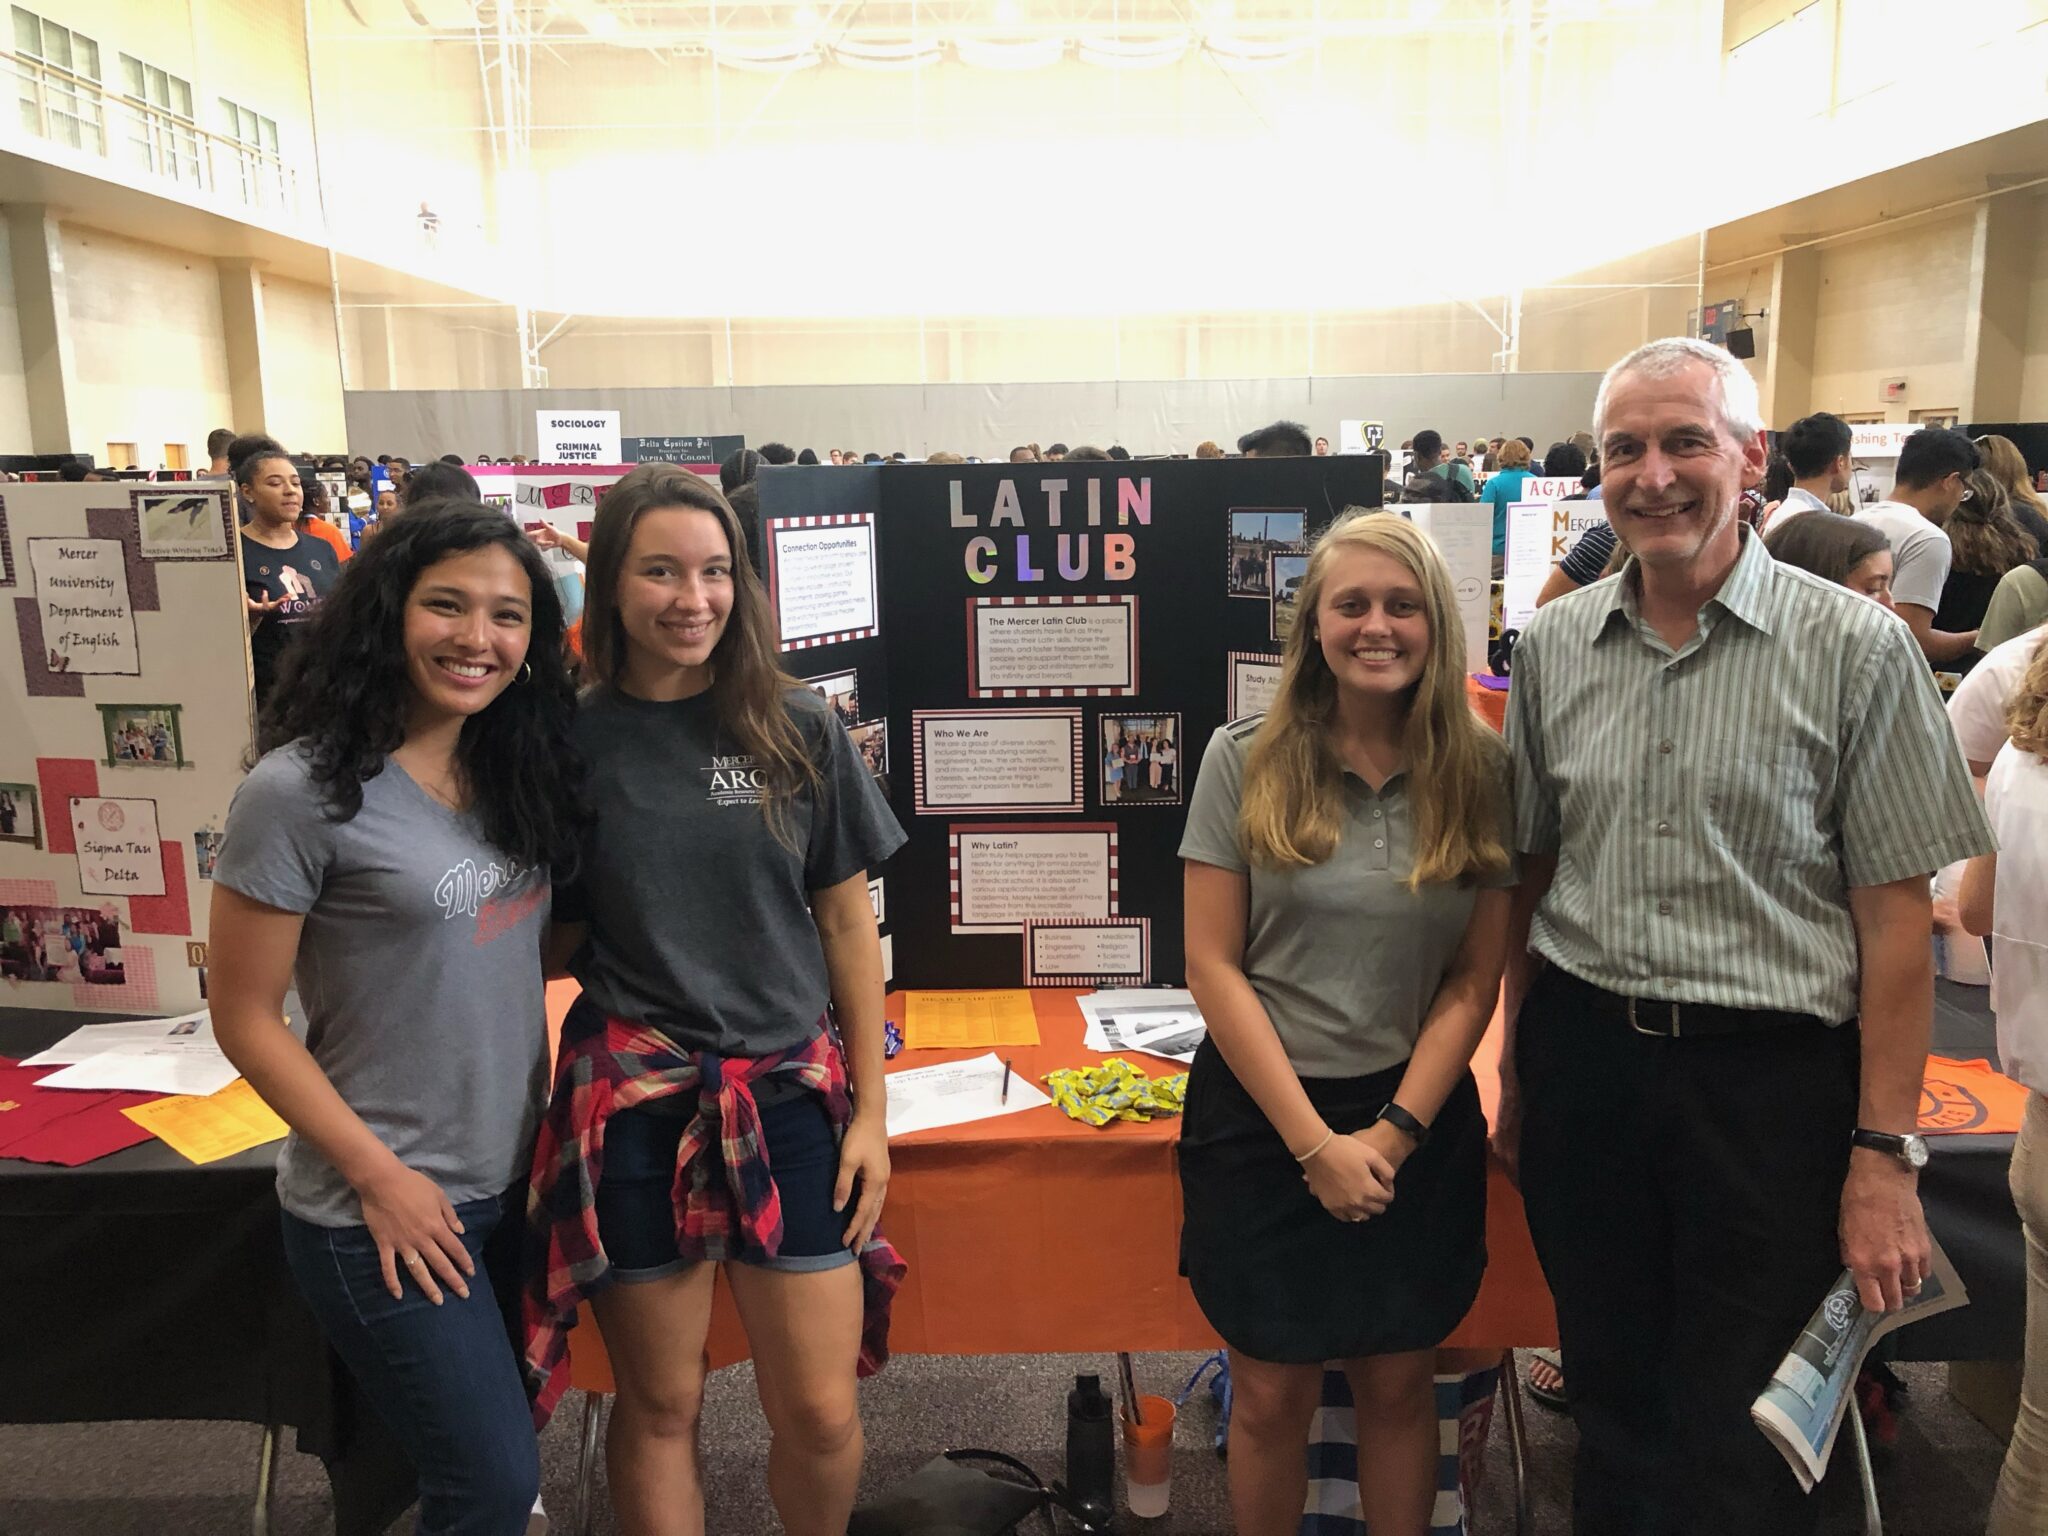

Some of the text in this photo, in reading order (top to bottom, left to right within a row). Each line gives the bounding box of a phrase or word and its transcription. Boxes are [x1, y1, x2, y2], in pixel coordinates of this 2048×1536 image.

[550, 420, 606, 428] SOCIOLOGY
[556, 443, 602, 451] CRIMINAL
[639, 438, 660, 447] Delta
[664, 438, 692, 449] Epsilon
[558, 452, 597, 460] JUSTICE
[950, 478, 1151, 527] LATIN
[783, 540, 857, 553] Connection Opportunities
[58, 548, 98, 559] Mercer
[965, 534, 1136, 584] CLUB
[49, 603, 124, 624] Department
[989, 618, 1004, 626] The
[1066, 617, 1087, 625] Club
[58, 632, 120, 653] of English
[1246, 674, 1266, 685] Study
[84, 841, 151, 861] Sigma Tau
[971, 841, 1018, 850] Why Latin?
[105, 868, 139, 881] Delta
[435, 858, 539, 920] Merc
